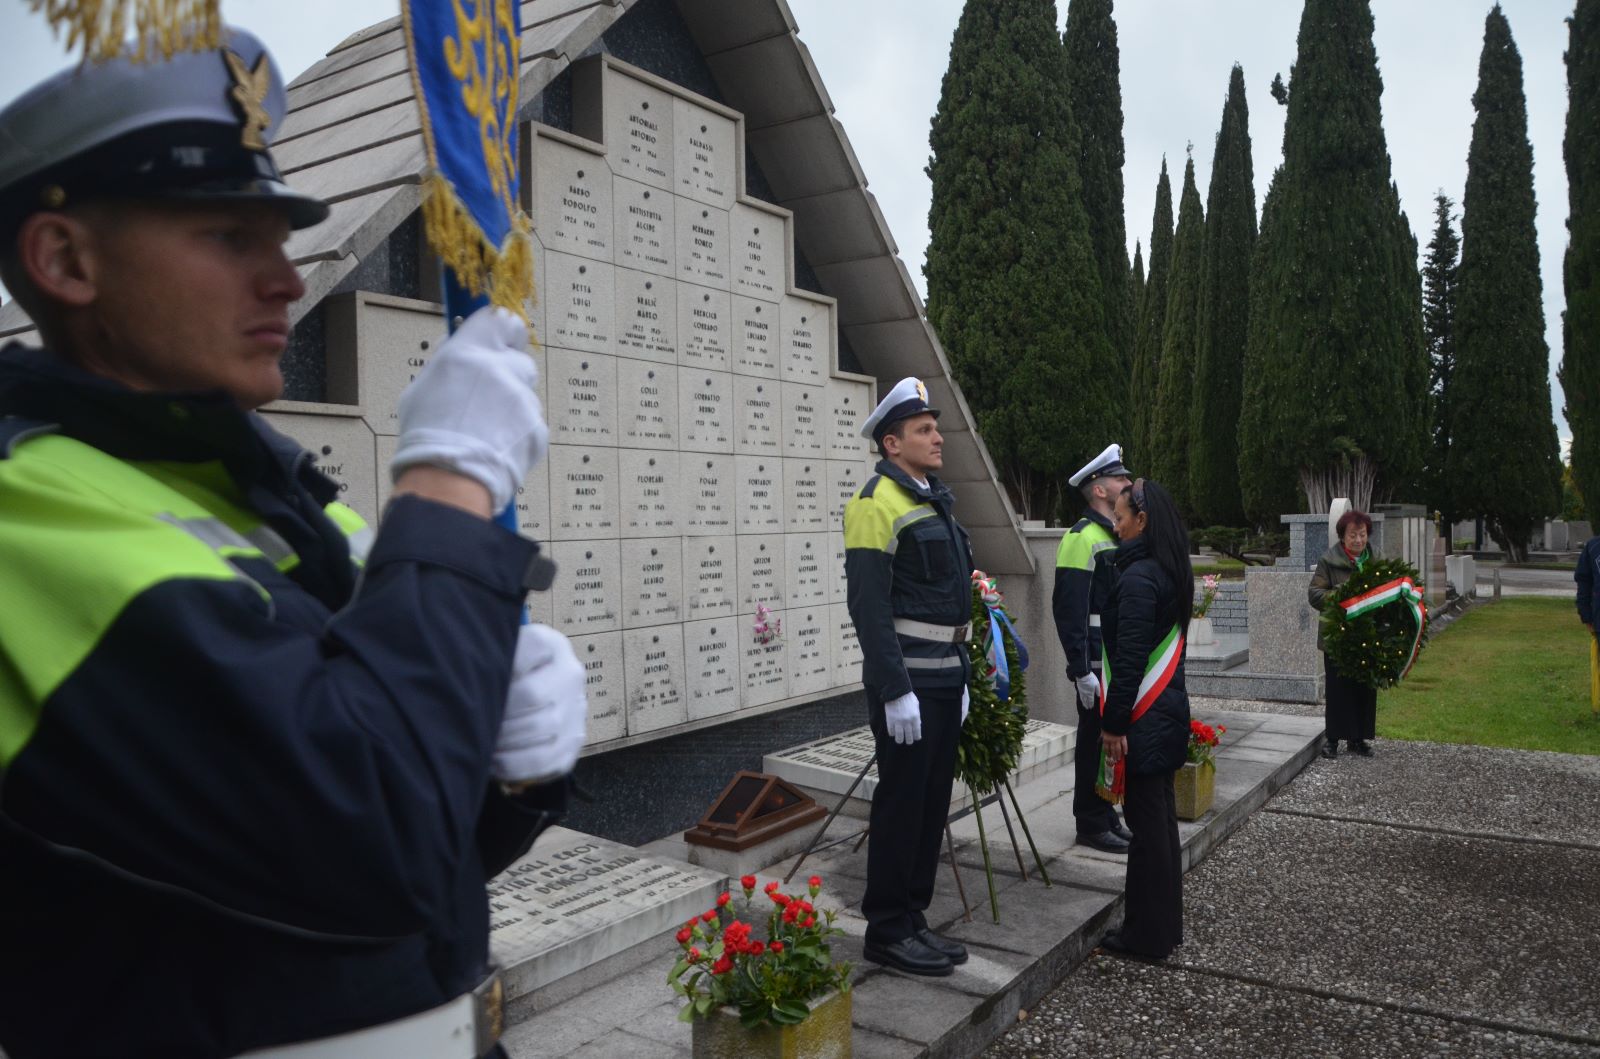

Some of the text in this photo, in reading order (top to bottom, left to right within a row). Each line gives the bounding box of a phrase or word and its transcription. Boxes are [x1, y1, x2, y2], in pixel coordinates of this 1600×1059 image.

[630, 129, 656, 143] ANTONIO
[695, 152, 708, 162] LUIGI
[569, 186, 590, 197] BARBO
[563, 198, 596, 213] RODOLFO
[694, 237, 712, 248] ROMEO
[571, 282, 591, 293] BETTA
[572, 297, 590, 307] LUIGI
[693, 322, 717, 331] CORRADO
[568, 378, 597, 387] COLAUTTI
[640, 386, 657, 395] COLLI
[640, 400, 659, 408] CARLO
[316, 463, 344, 475] EVIDÉ
[637, 475, 663, 483] FLOREANI
[699, 477, 717, 485] FOGAR
[575, 487, 596, 495] MARIO
[643, 488, 659, 496] LUIGI
[642, 563, 663, 571] GORIUP
[700, 559, 721, 567] GREGORI
[699, 572, 722, 580] GIOVANNI
[752, 568, 772, 576] GIORGIO
[574, 581, 602, 590] GIOVANNI
[584, 660, 602, 670] ALNER
[586, 674, 602, 684] ARIO
[506, 844, 599, 877] AGLI EROI
[487, 857, 602, 899] RTIRI PER IL
[513, 893, 533, 903] E
[534, 856, 640, 895] DEMOCRAZIA
[546, 885, 608, 909] LIBERAZIONE
